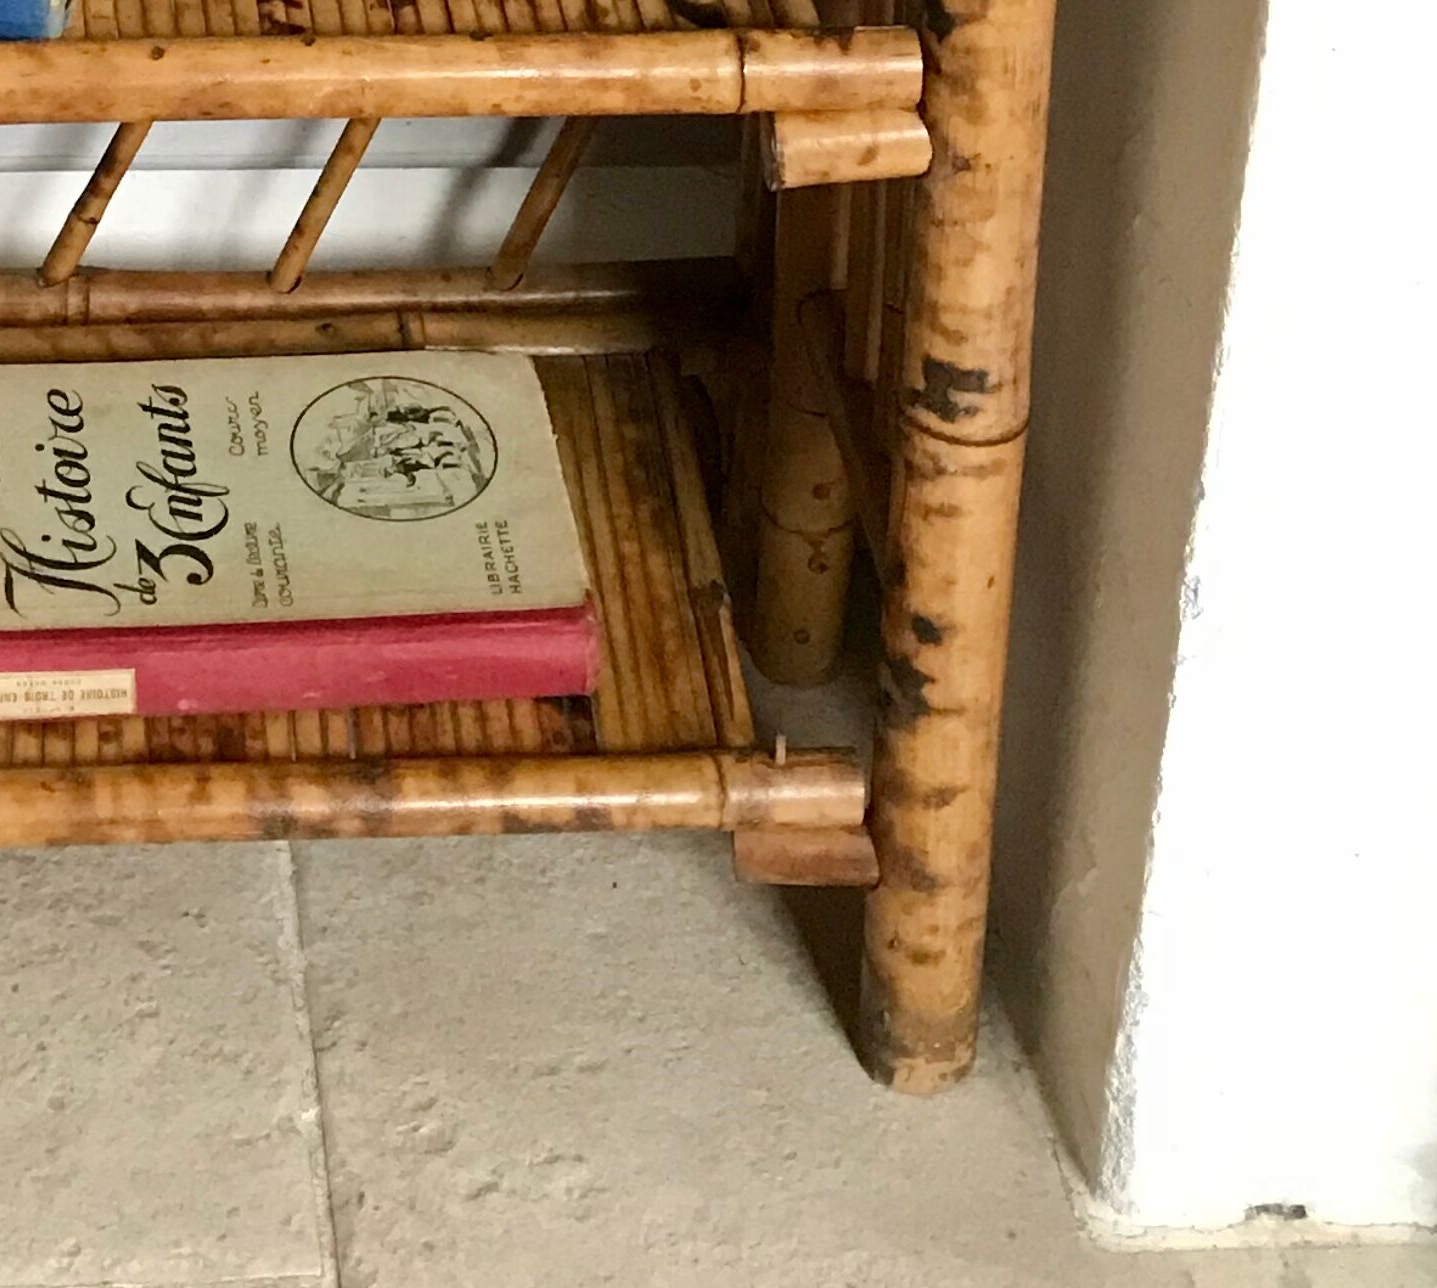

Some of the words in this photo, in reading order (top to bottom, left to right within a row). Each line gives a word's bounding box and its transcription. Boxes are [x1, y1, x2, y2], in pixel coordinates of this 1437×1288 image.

[248, 390, 269, 456] moyen
[125, 383, 230, 541] Enfants
[0, 388, 121, 619] Histoire
[113, 576, 157, 606] de
[135, 538, 214, 586] 3
[475, 521, 503, 595] LIBRAIRIE
[494, 519, 522, 594] HACHETTE
